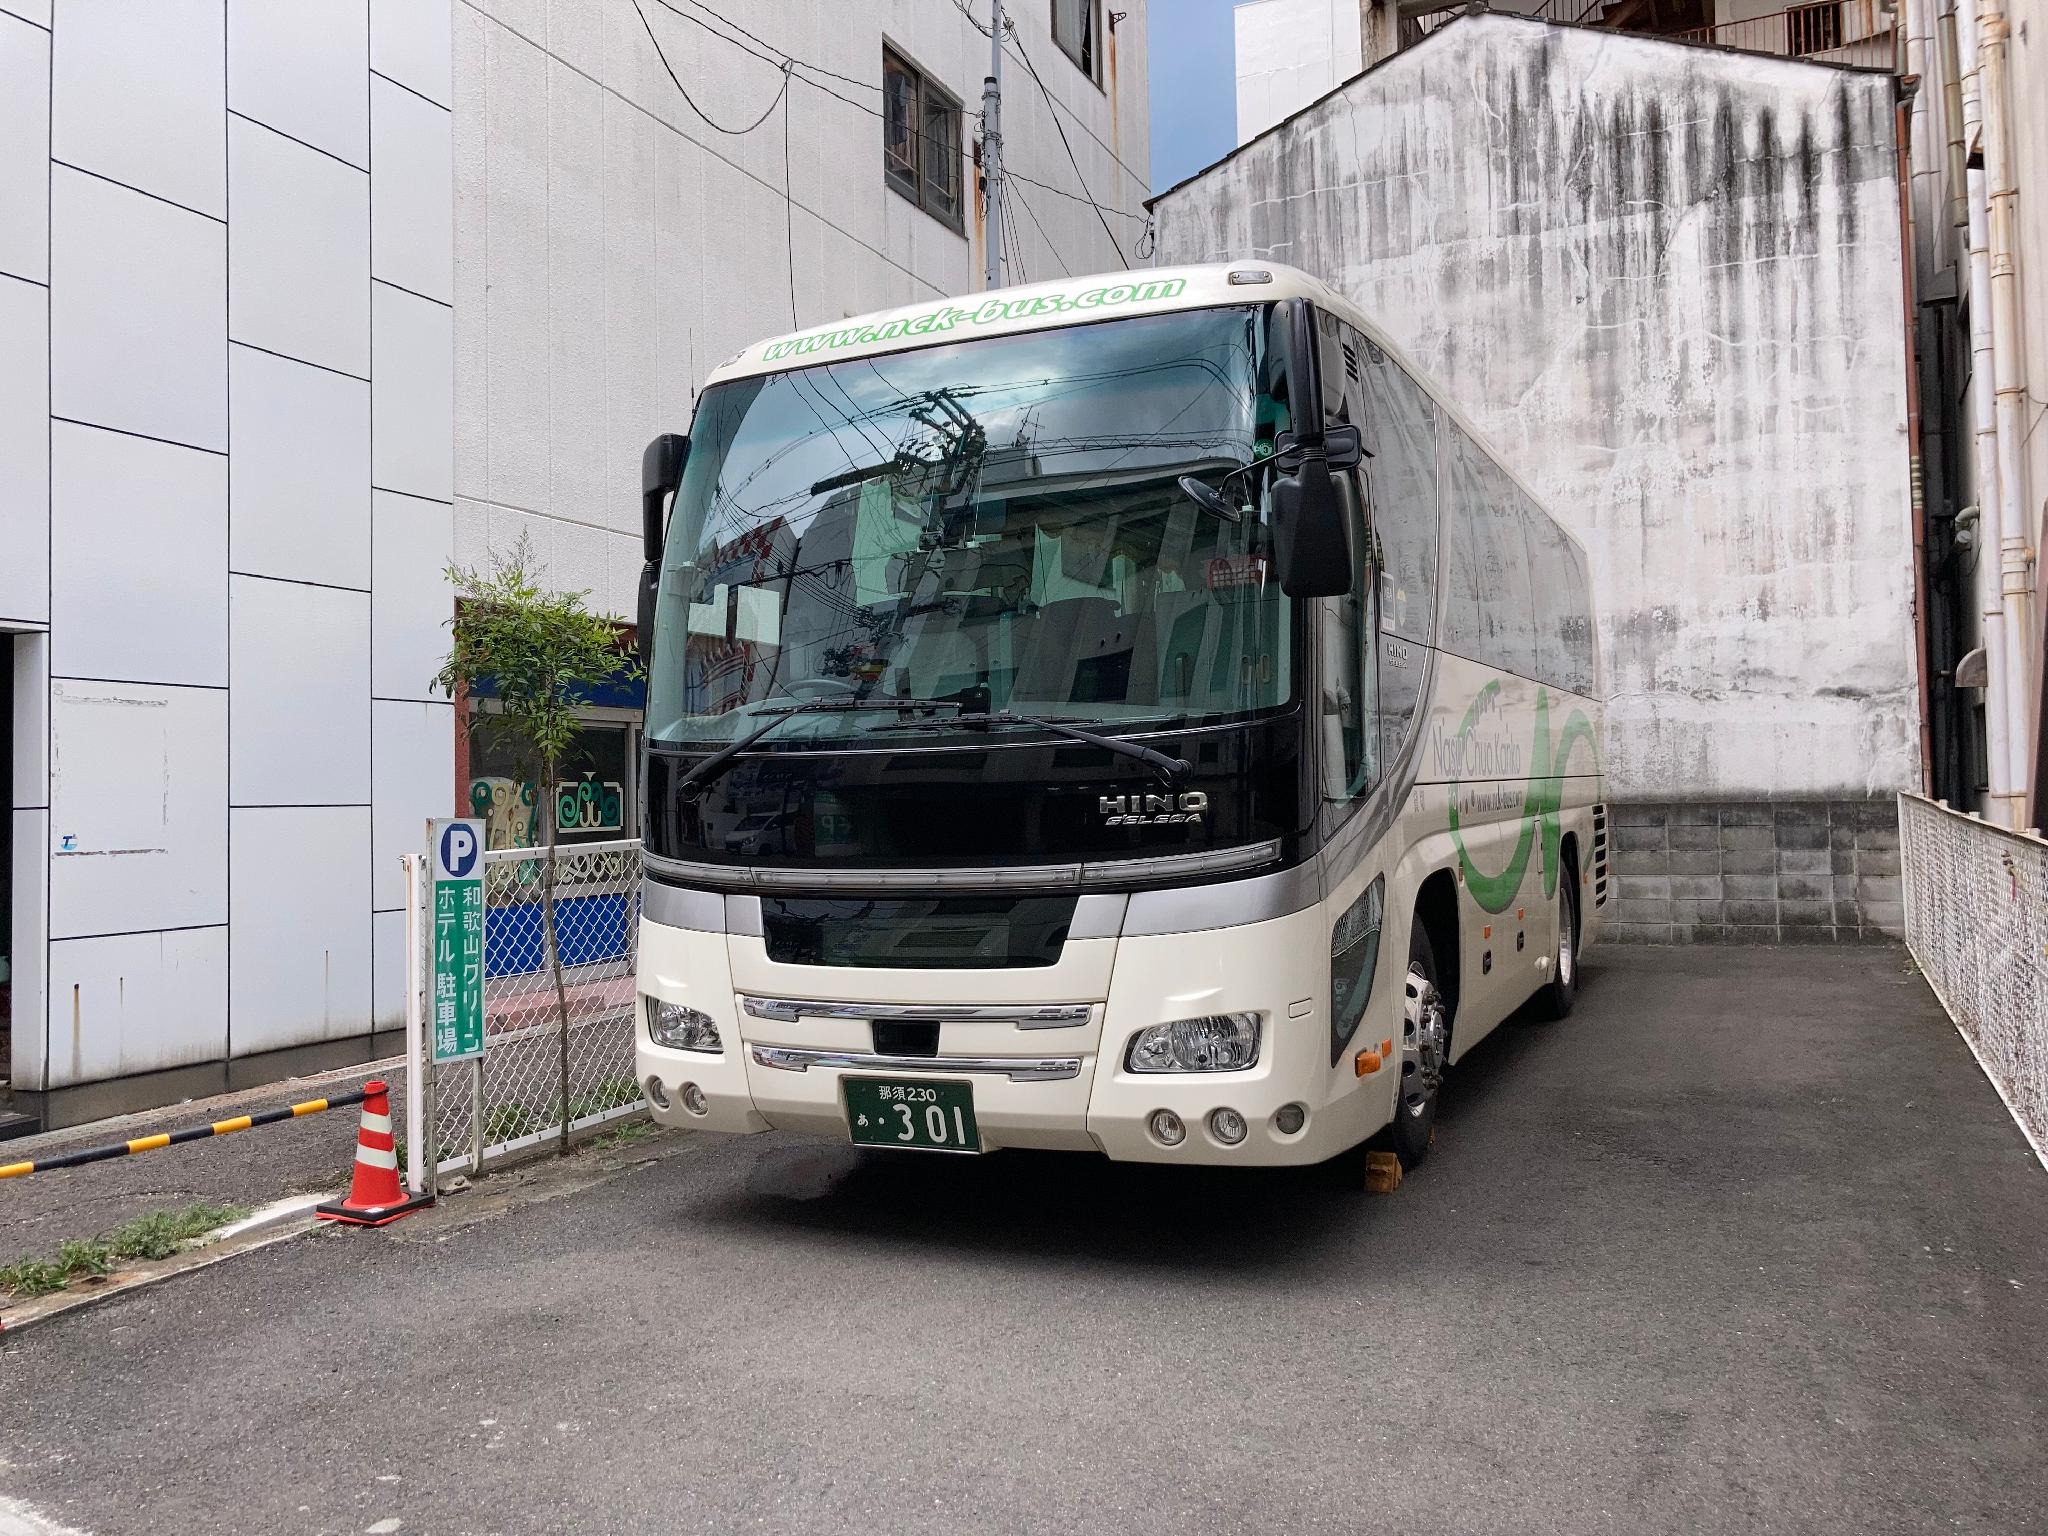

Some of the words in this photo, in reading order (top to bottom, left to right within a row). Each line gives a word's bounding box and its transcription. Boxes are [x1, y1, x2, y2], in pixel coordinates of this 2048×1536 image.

[763, 278, 1186, 361] www.nck-bus.com
[1387, 643, 1408, 660] HINO
[1465, 726, 1494, 777] Chuo
[1099, 791, 1208, 814] HINO
[449, 830, 473, 872] P
[462, 886, 482, 1053] 和歌山グリーン
